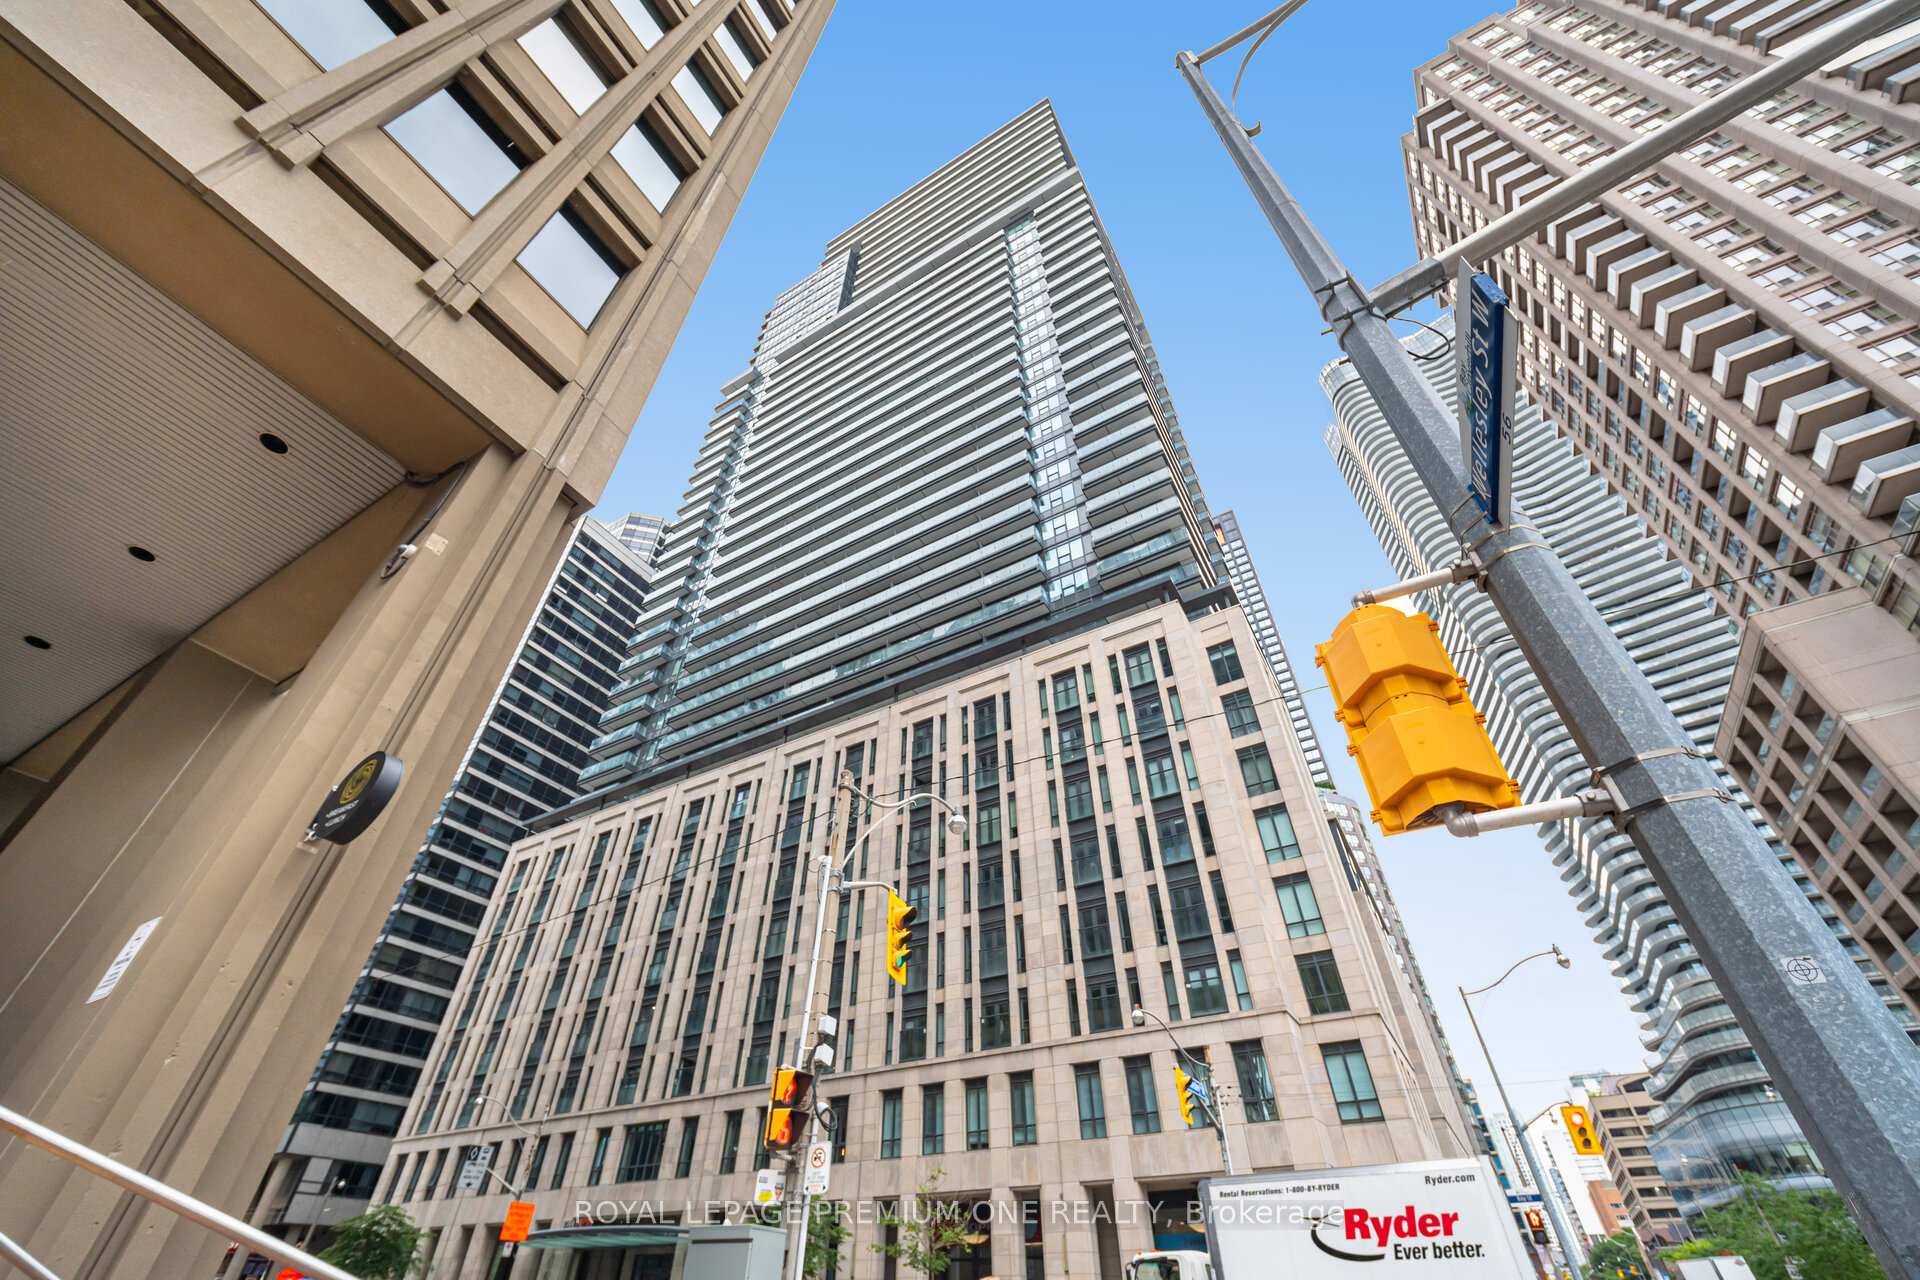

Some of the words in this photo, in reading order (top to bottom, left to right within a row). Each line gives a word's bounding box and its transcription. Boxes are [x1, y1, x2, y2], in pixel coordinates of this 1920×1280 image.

[1471, 287, 1488, 327] W
[1472, 328, 1488, 368] St
[1471, 366, 1492, 499] Wellesley
[1502, 411, 1512, 445] 56
[1219, 1190, 1239, 1198] Rental
[1240, 1187, 1284, 1196] Reservations:
[1424, 1174, 1476, 1186] Ryder.com
[1344, 1206, 1459, 1247] Ryder
[1394, 1244, 1428, 1260] Ever
[1433, 1241, 1486, 1259] better.
